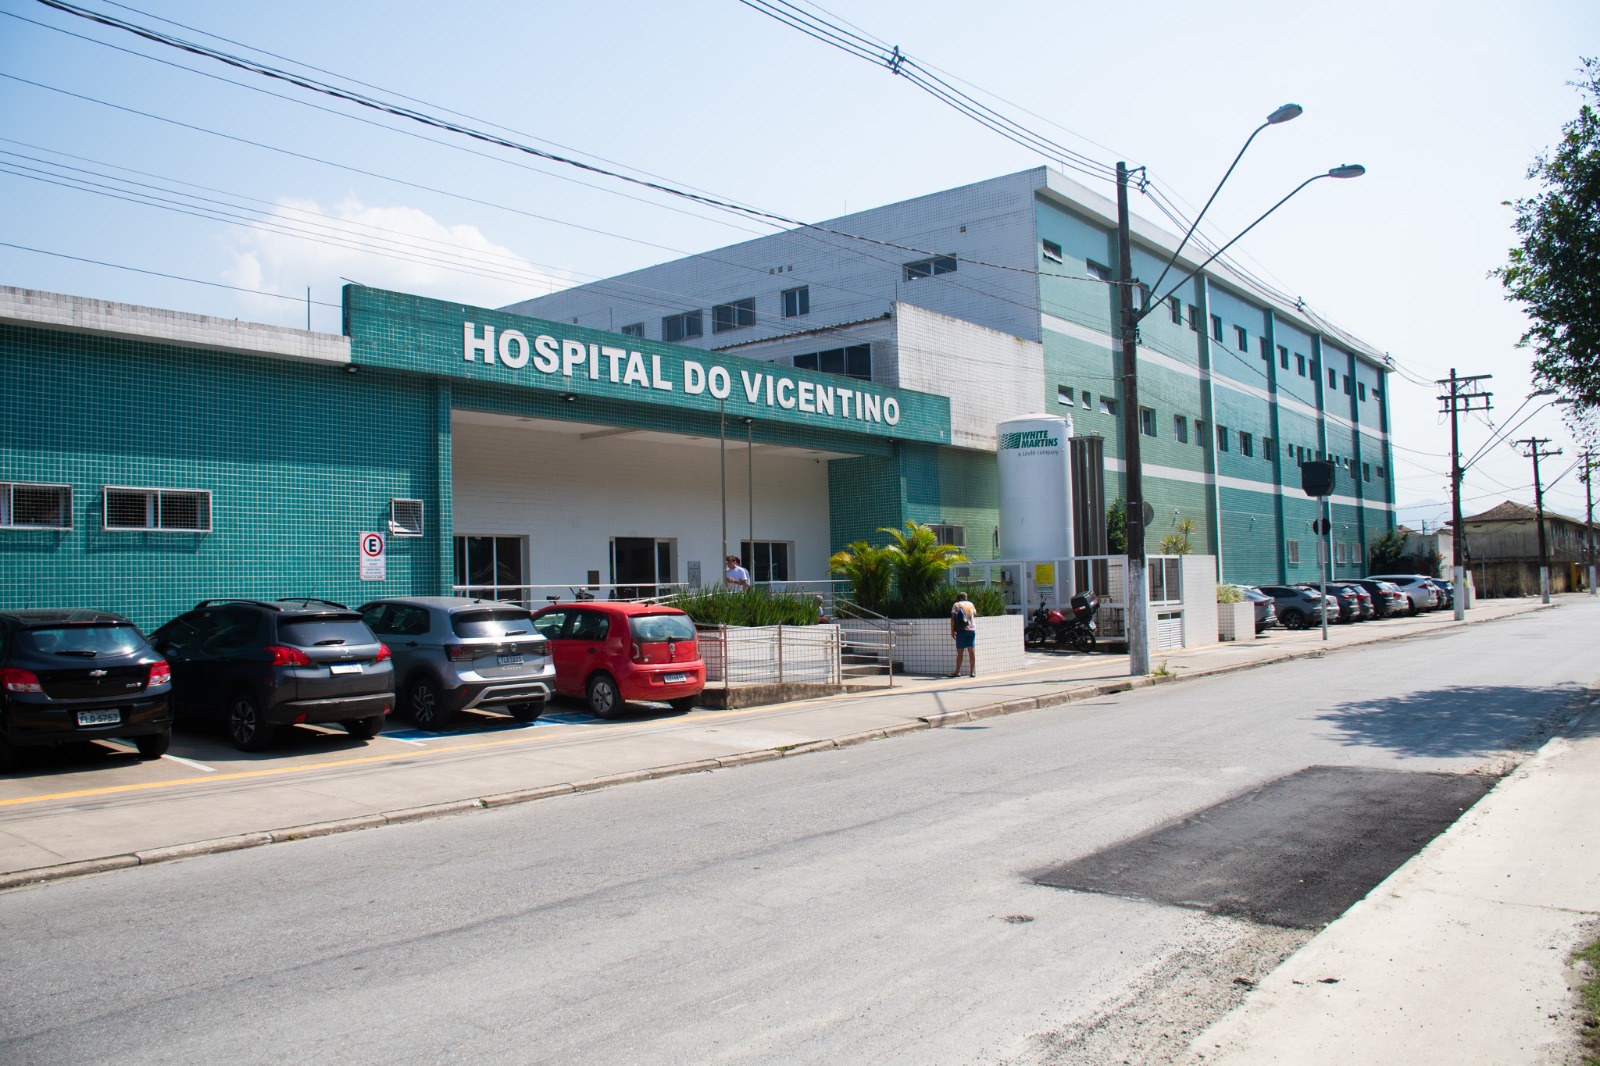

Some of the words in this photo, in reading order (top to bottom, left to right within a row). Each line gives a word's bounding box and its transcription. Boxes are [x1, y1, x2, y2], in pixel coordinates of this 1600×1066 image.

[463, 321, 673, 391] HOSPITAL
[683, 360, 731, 399] DO
[740, 369, 901, 426] VICENTINO
[1021, 430, 1048, 439] WHITE
[1021, 438, 1058, 448] MARTINS
[369, 538, 377, 553] E
